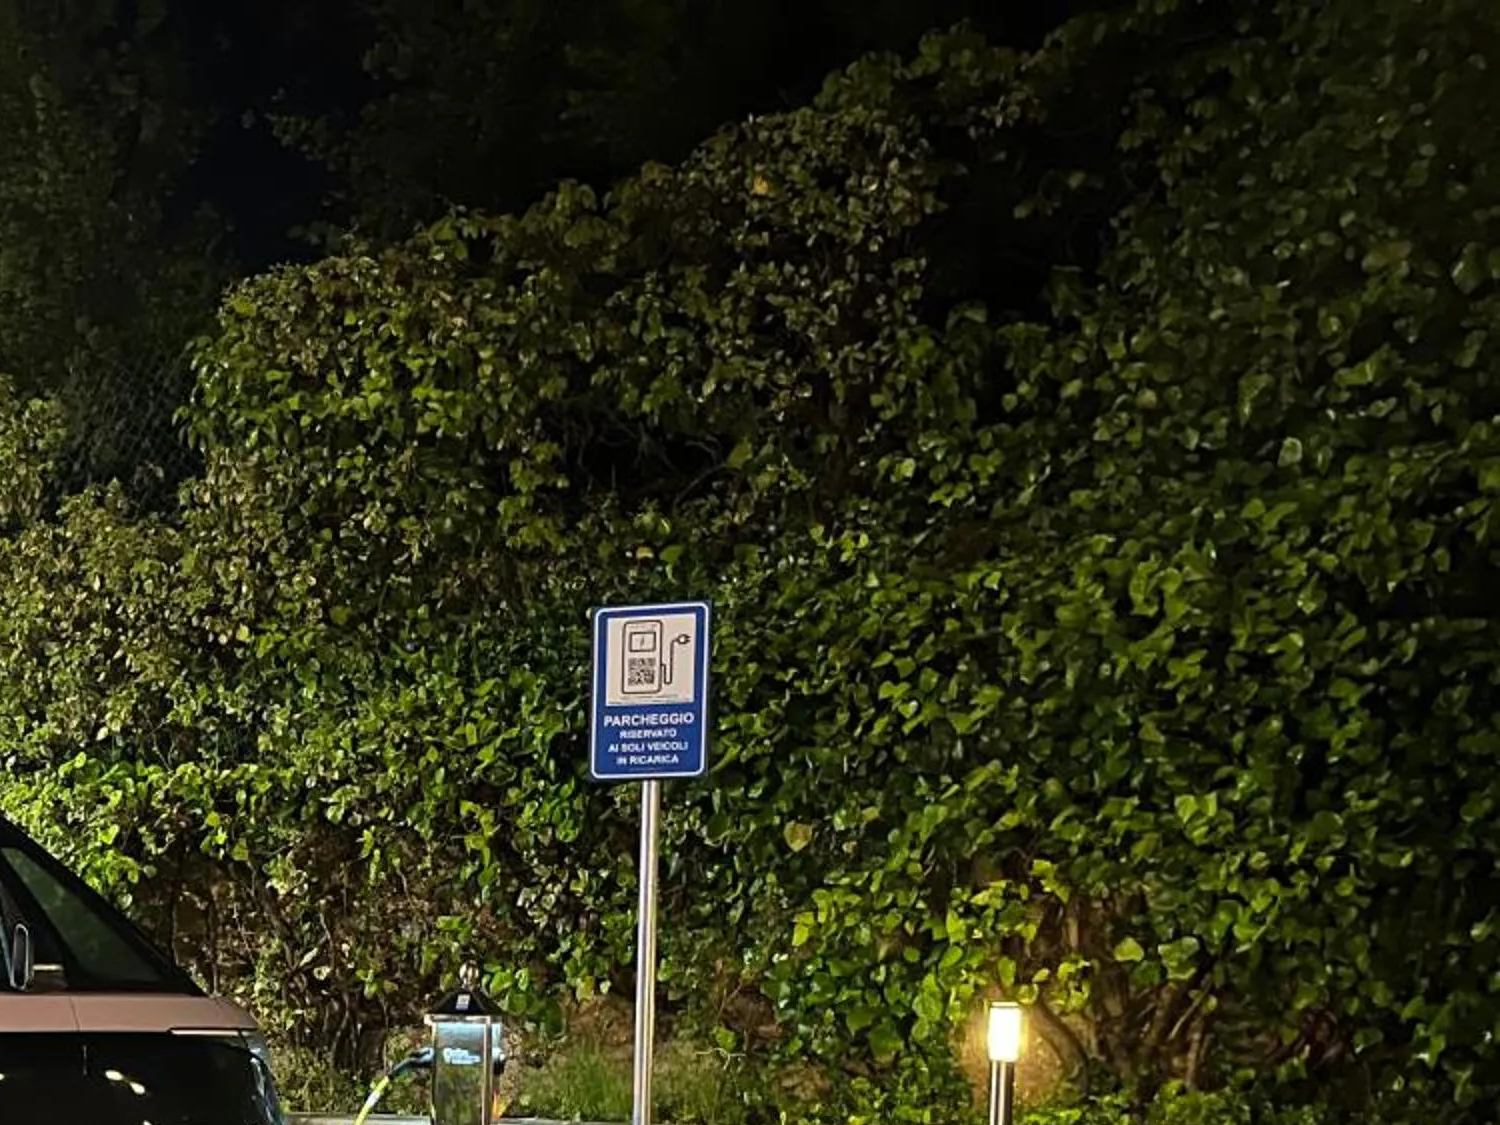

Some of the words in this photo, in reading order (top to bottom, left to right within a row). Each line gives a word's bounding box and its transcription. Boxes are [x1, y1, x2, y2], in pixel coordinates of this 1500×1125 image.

[604, 712, 695, 727] PARCHEGGIO
[619, 728, 677, 738] RISERVATO
[607, 743, 619, 752] AI
[621, 743, 645, 752] SOLI
[647, 741, 689, 751] VEICOLI
[616, 756, 627, 765] IN
[629, 754, 679, 764] RICARICA
